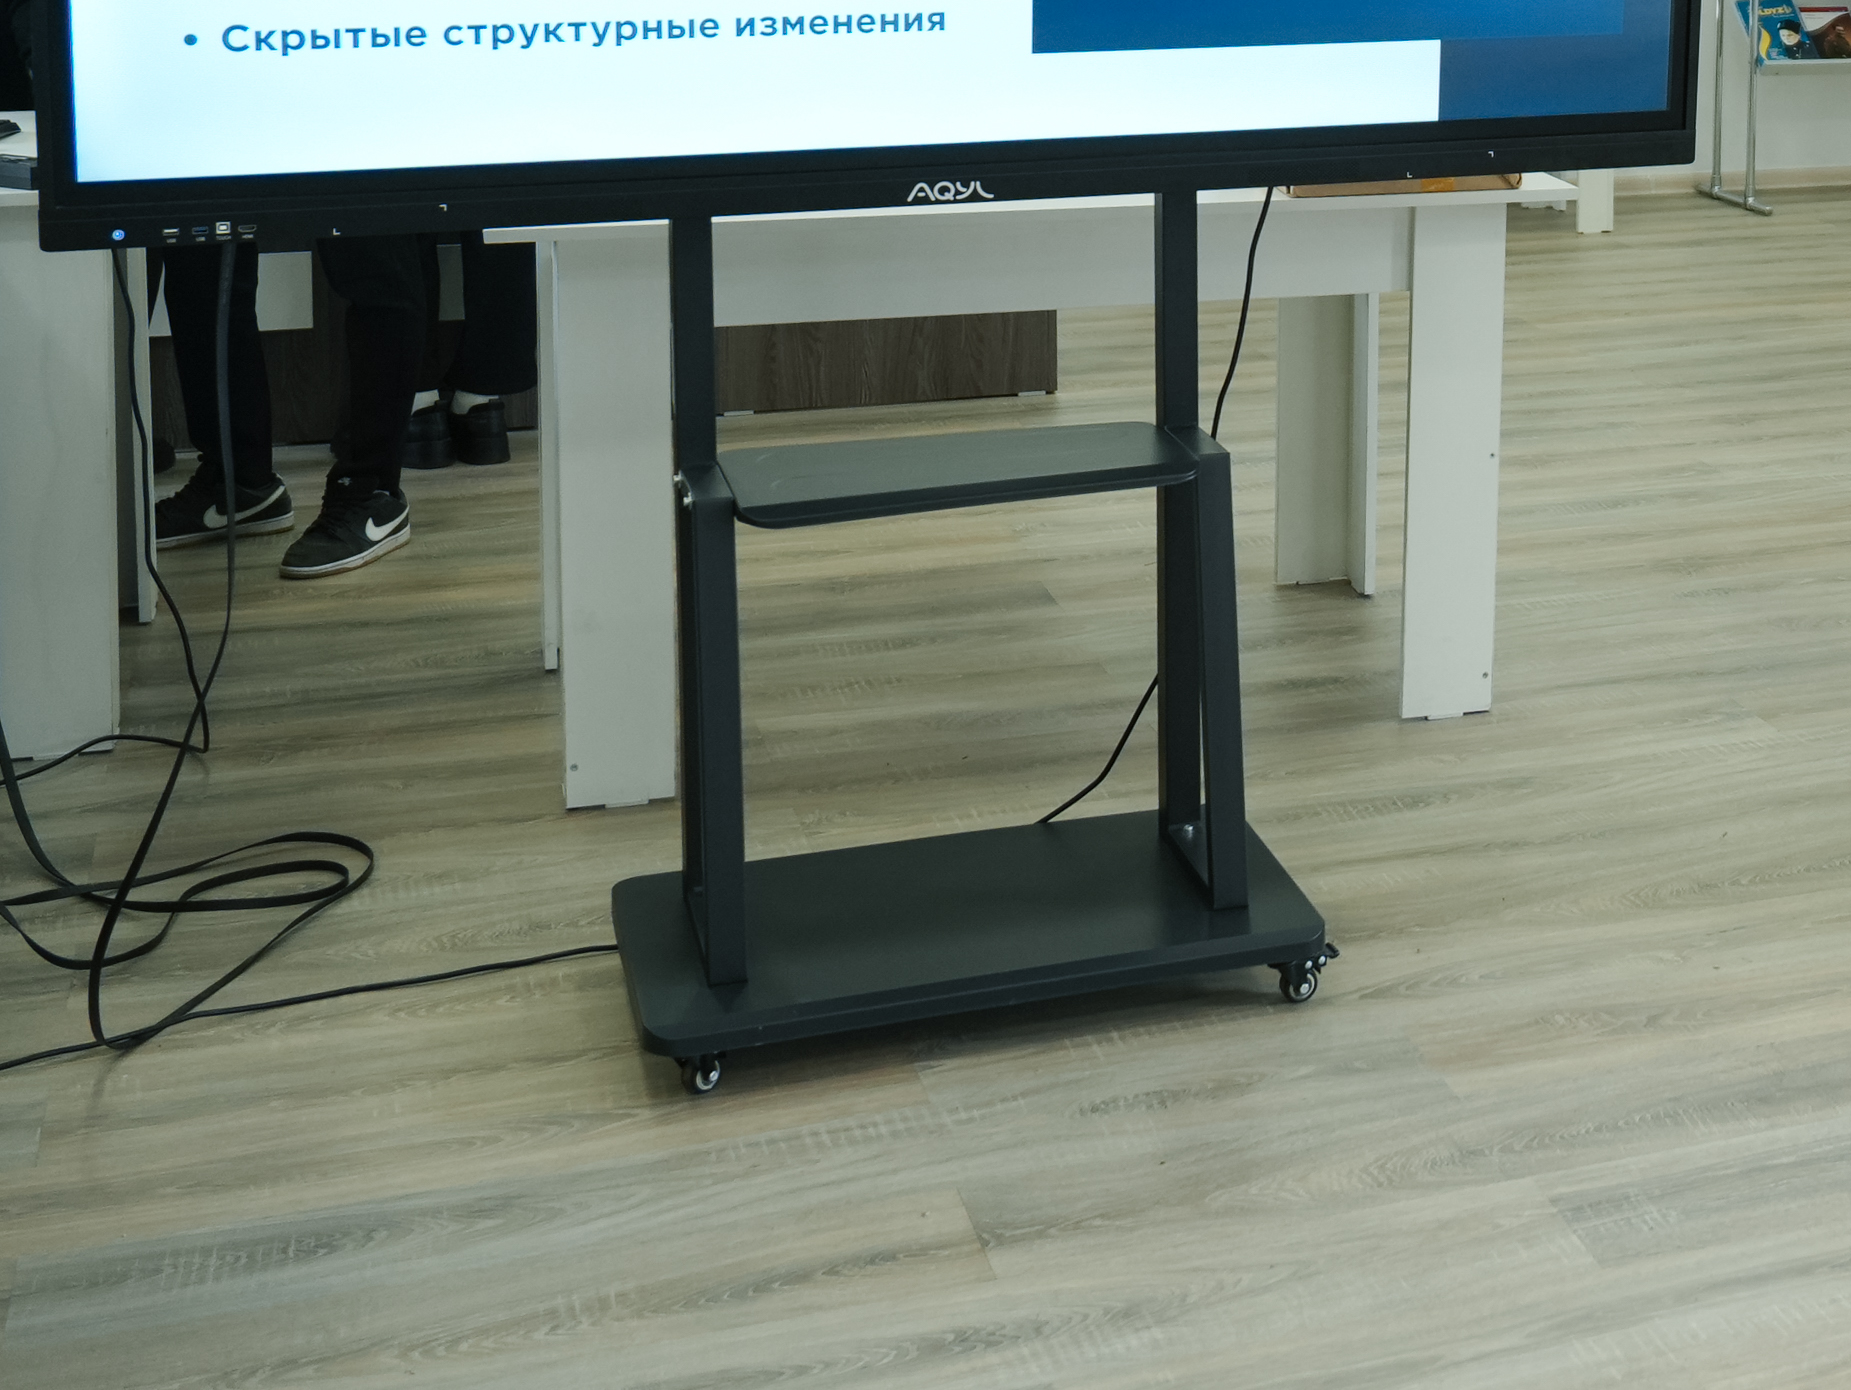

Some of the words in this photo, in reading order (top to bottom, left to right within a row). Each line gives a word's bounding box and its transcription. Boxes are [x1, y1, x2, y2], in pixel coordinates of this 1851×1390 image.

[221, 24, 428, 57] Скрытые
[443, 17, 720, 51] структурные
[735, 11, 946, 38] изменения
[907, 181, 994, 202] AQYL
